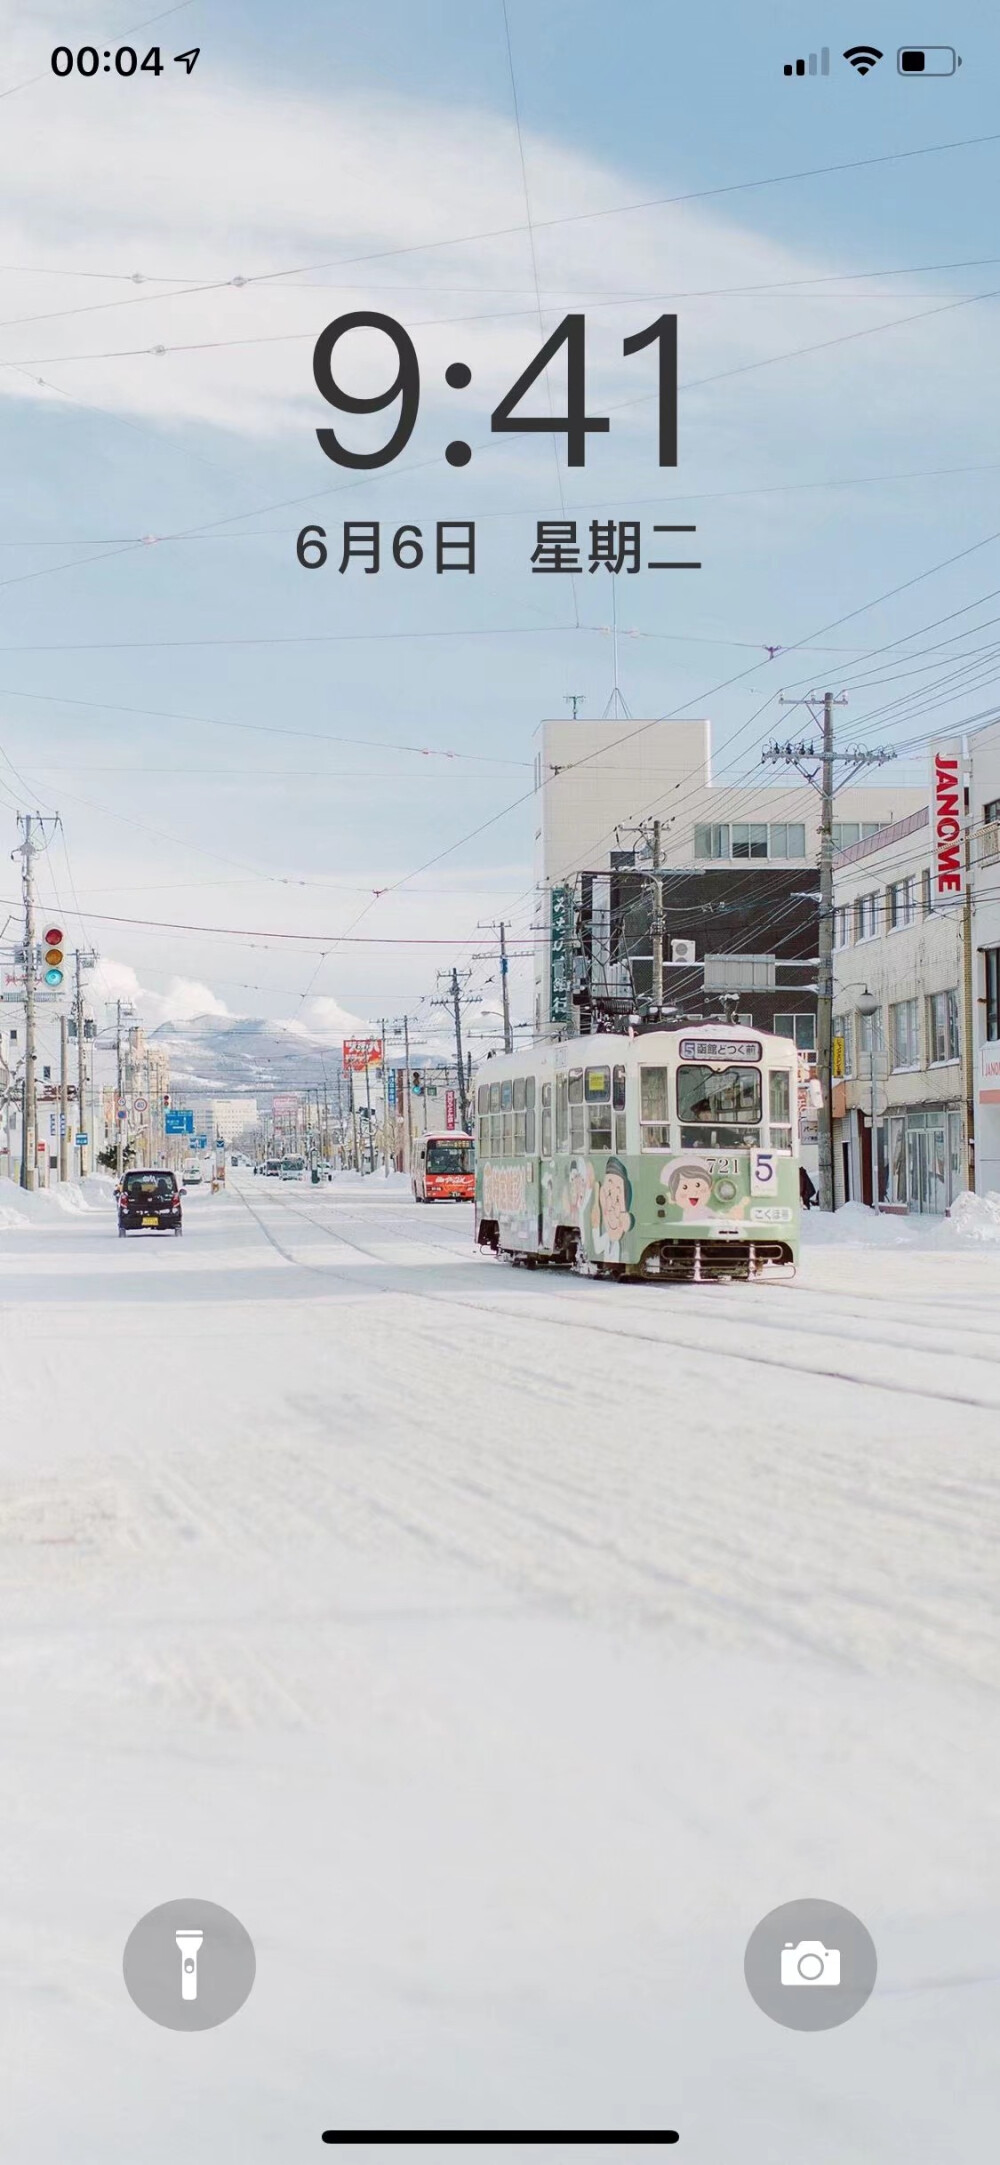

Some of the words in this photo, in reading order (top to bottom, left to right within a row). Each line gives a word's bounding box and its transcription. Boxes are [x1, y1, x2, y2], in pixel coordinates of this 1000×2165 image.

[935, 752, 961, 892] JANOME
[684, 1042, 696, 1058] 5
[706, 1158, 740, 1175] 721
[755, 1153, 774, 1183] 5
